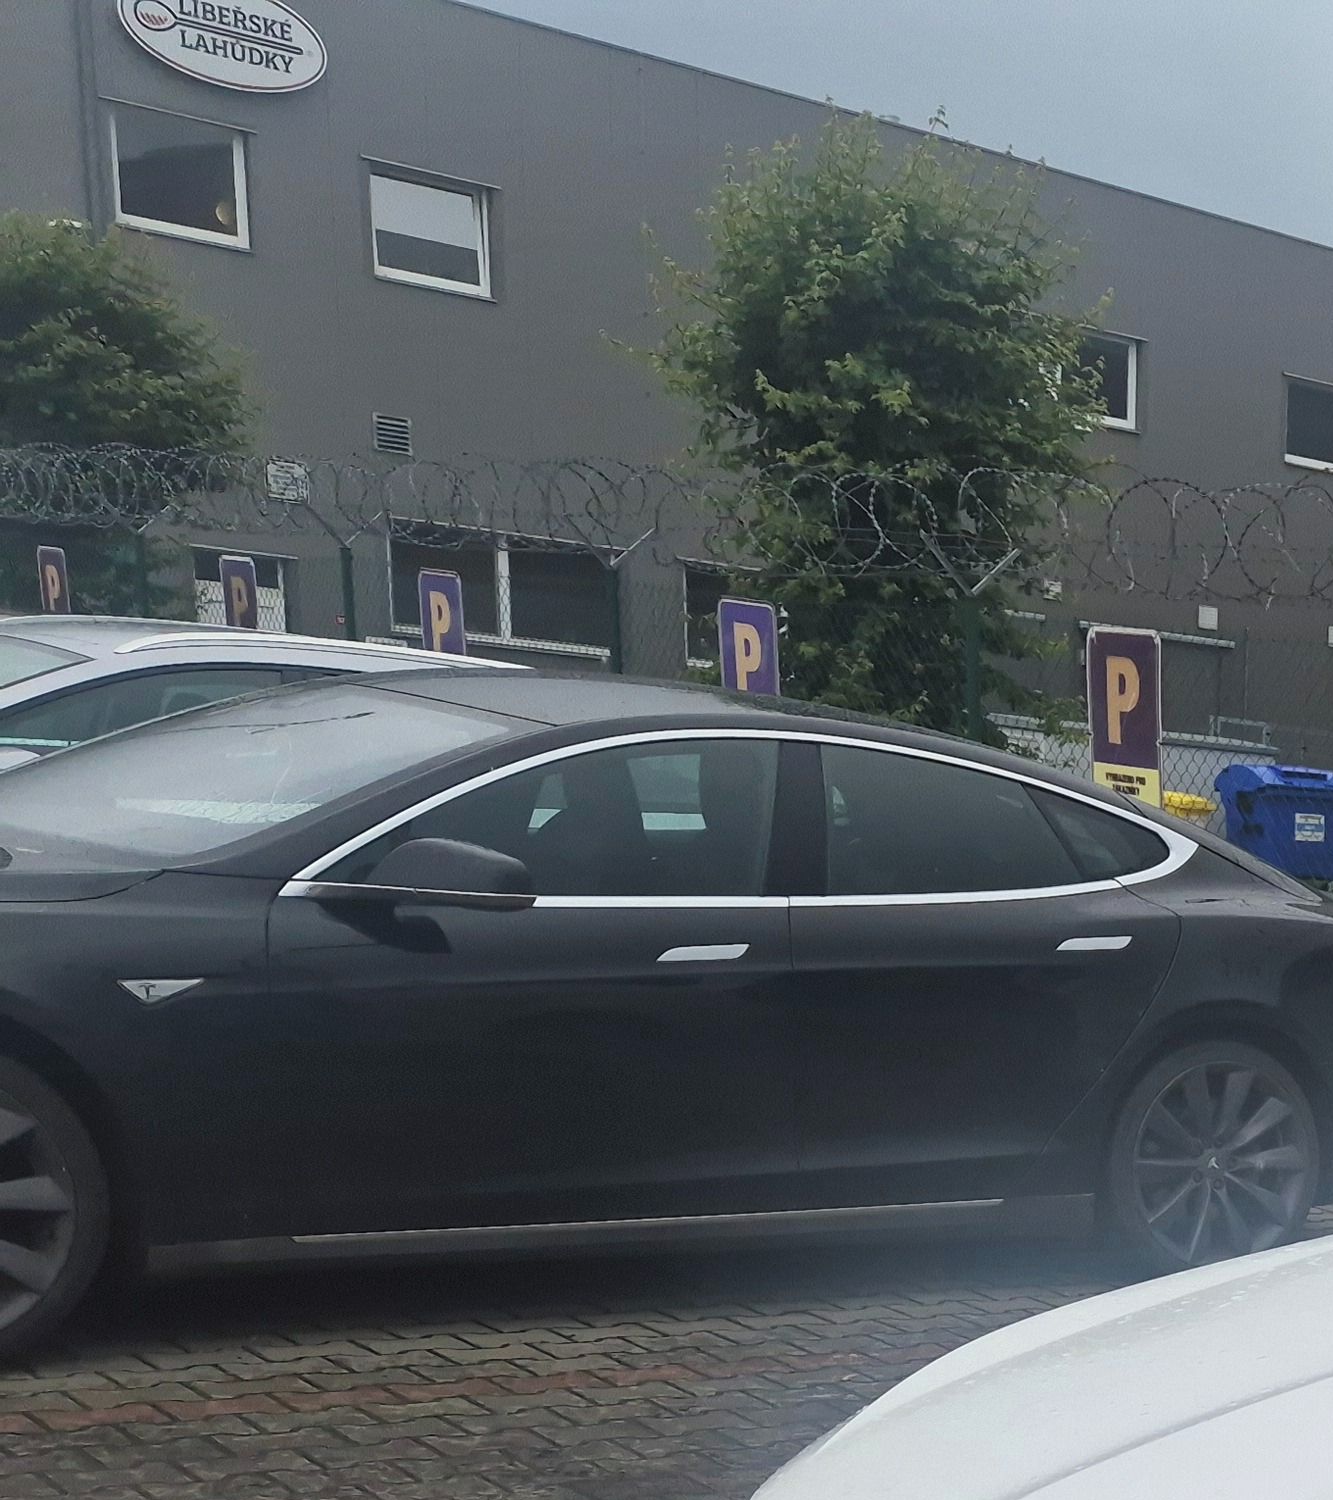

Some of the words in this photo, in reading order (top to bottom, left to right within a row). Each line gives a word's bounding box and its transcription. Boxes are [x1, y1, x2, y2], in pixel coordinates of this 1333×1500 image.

[178, 0, 293, 42] LIBEŘSKÉ
[179, 29, 294, 74] LAHŮDKY
[45, 564, 61, 612] P
[230, 576, 248, 626] P
[429, 591, 451, 652] P
[733, 621, 762, 691] P
[1106, 656, 1141, 744] P
